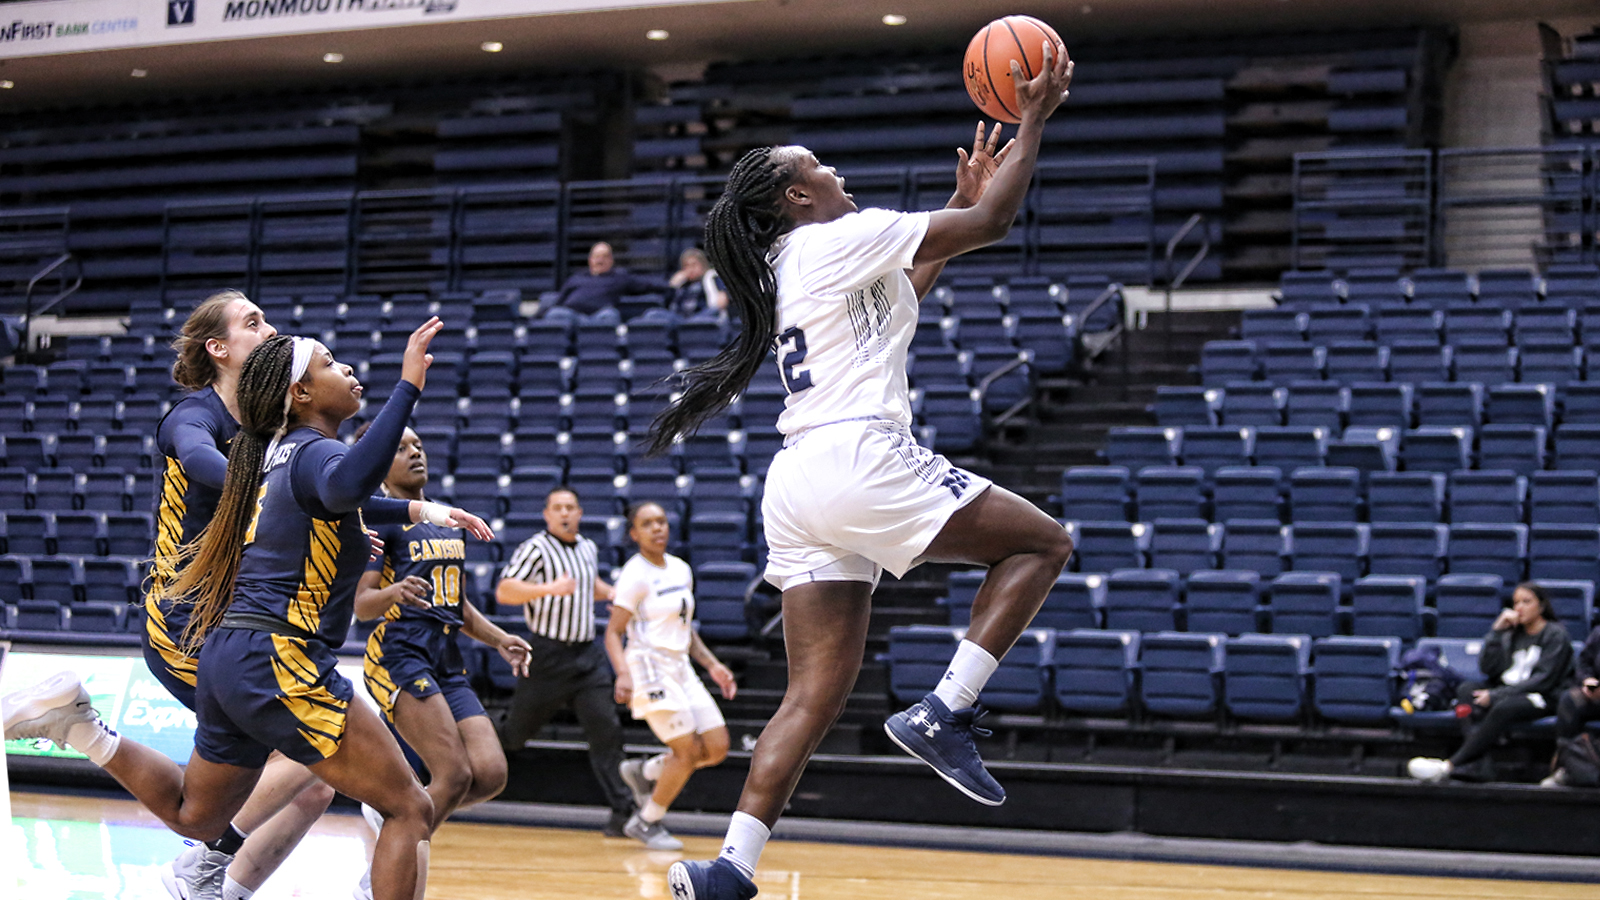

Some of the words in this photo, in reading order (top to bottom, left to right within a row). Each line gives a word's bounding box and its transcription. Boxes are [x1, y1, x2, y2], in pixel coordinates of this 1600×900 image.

[56, 22, 90, 37] BANK
[91, 18, 138, 35] CENTER
[431, 565, 460, 606] 10
[679, 597, 687, 625] 4
